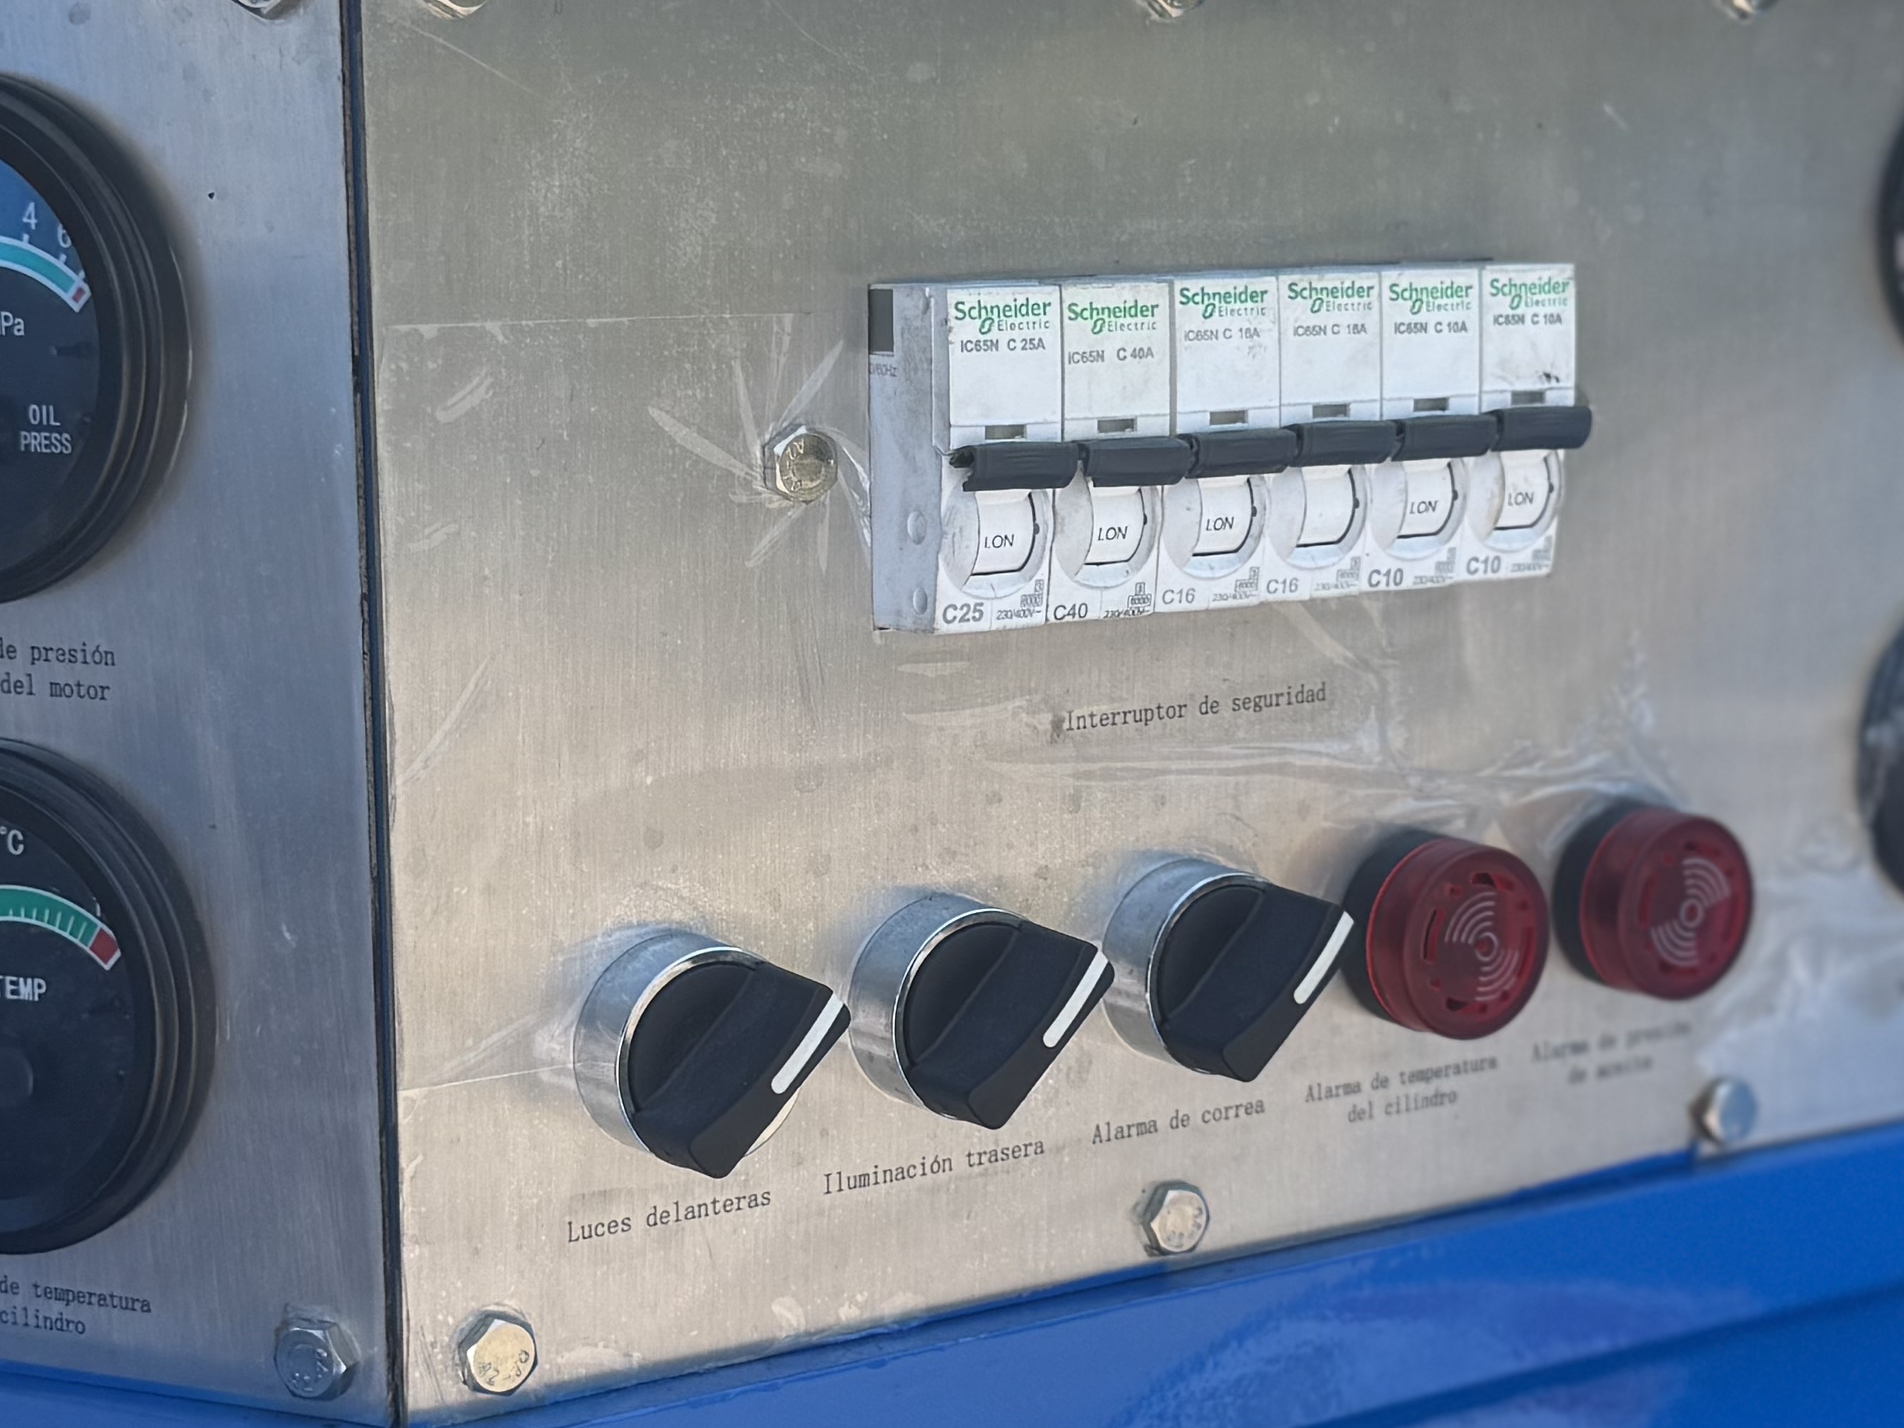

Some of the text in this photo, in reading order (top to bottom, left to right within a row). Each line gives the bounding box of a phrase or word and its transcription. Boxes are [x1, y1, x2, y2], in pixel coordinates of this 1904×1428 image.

[22, 202, 38, 229] 4
[1179, 285, 1268, 306] Schneider
[1288, 281, 1374, 300] Schneider
[1389, 279, 1473, 302] Schneider
[1490, 276, 1571, 297] Schneider
[954, 298, 1052, 320] Schneider
[1067, 300, 1159, 321] Schneider
[1218, 306, 1266, 318] Electric
[1326, 300, 1372, 312] Electric
[997, 319, 1050, 332] Electric
[1108, 321, 1156, 333] Electric
[1331, 323, 1340, 335] C
[1434, 321, 1443, 333] C
[1531, 313, 1540, 326] C
[1007, 338, 1018, 351] C
[1021, 338, 1046, 351] 25A
[1223, 328, 1232, 340] C
[1117, 347, 1127, 361] C
[1130, 347, 1154, 360] 40A
[29, 405, 60, 426] OIL
[20, 431, 72, 454] PRESS
[1466, 555, 1501, 575] C10
[1266, 578, 1299, 595] C16
[1367, 568, 1404, 588] C10
[1162, 588, 1196, 605] C16
[942, 602, 985, 624] C25
[1053, 603, 1089, 621] C40
[30, 642, 116, 667] presión
[0, 672, 36, 696] del
[49, 680, 111, 701] motor
[1066, 682, 1327, 731] Interruptor de seguridad
[0, 826, 25, 855] °C
[1305, 1056, 1499, 1103] Alarma de temperatura
[1347, 1087, 1458, 1123] del cilindro
[1092, 1099, 1266, 1145] Alarma de correa
[824, 1140, 1045, 1195] Iluminación trasera
[568, 1190, 772, 1243] Luces delanteras
[32, 1282, 152, 1313] temperatura
[0, 1306, 86, 1335] cilindro
